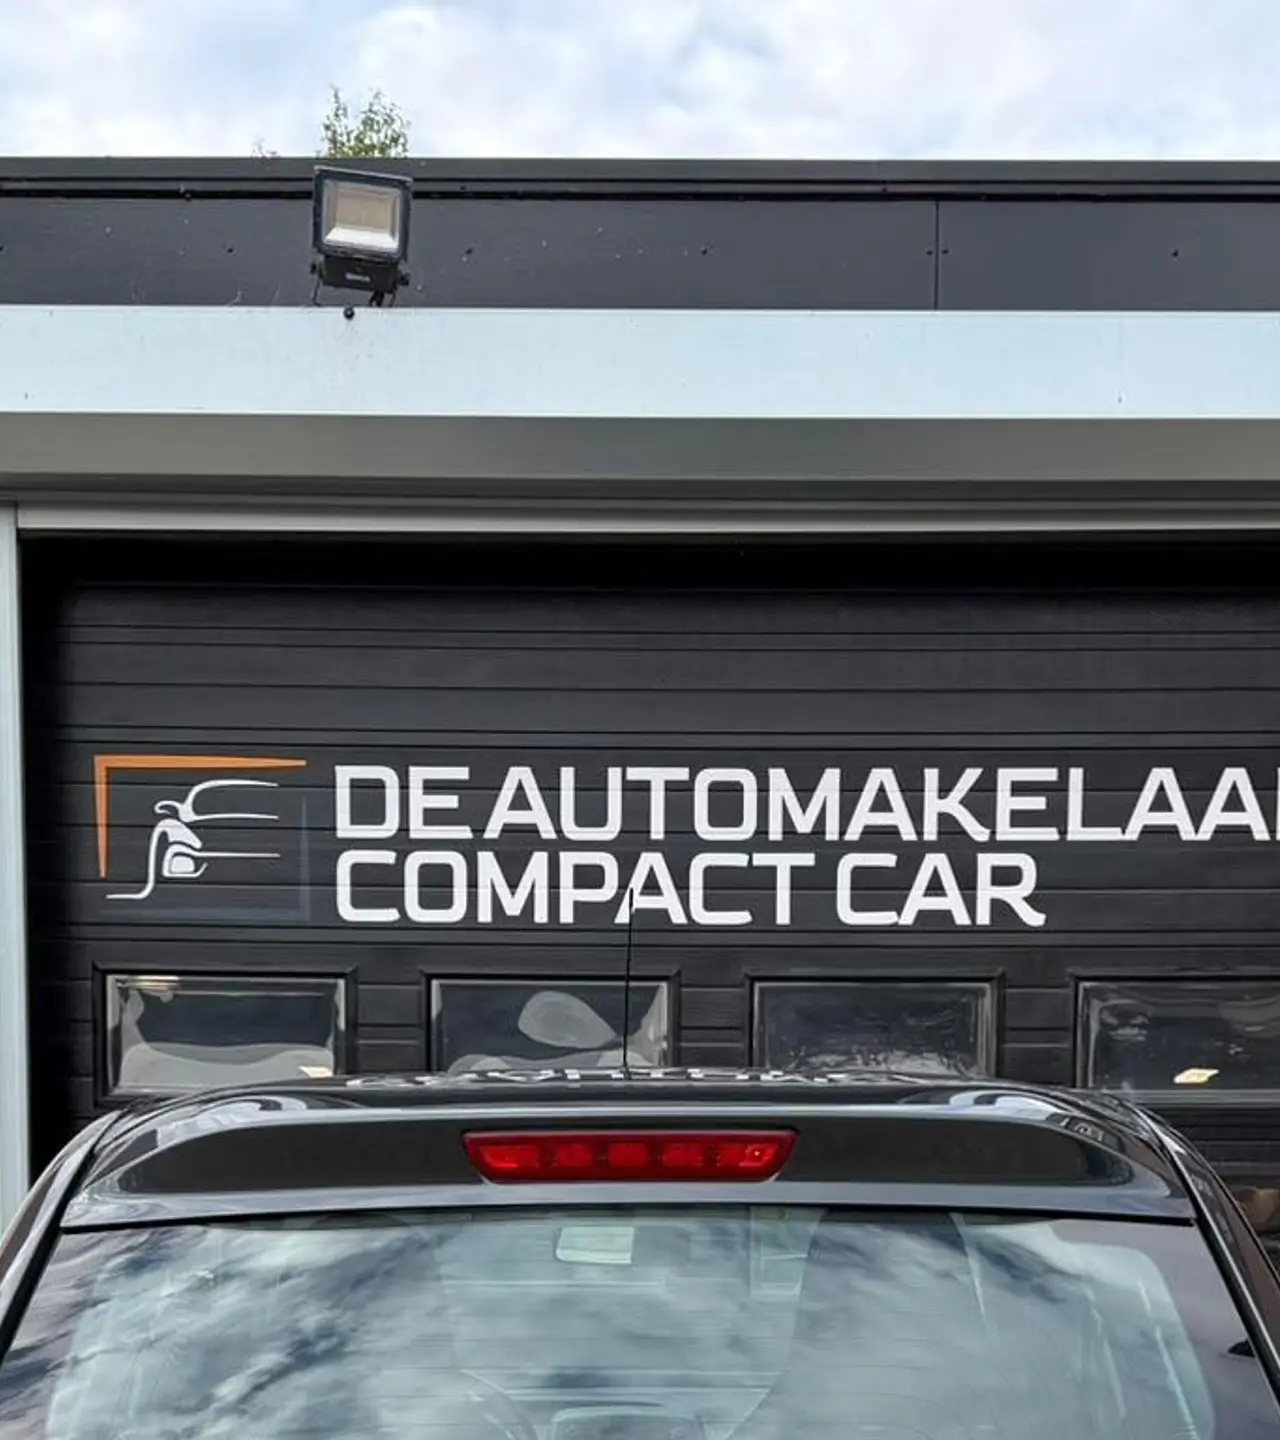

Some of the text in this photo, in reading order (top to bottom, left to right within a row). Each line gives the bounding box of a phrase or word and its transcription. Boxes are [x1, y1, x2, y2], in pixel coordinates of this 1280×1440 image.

[335, 765, 472, 841] DE
[335, 850, 1047, 928] COMPACT CAR
